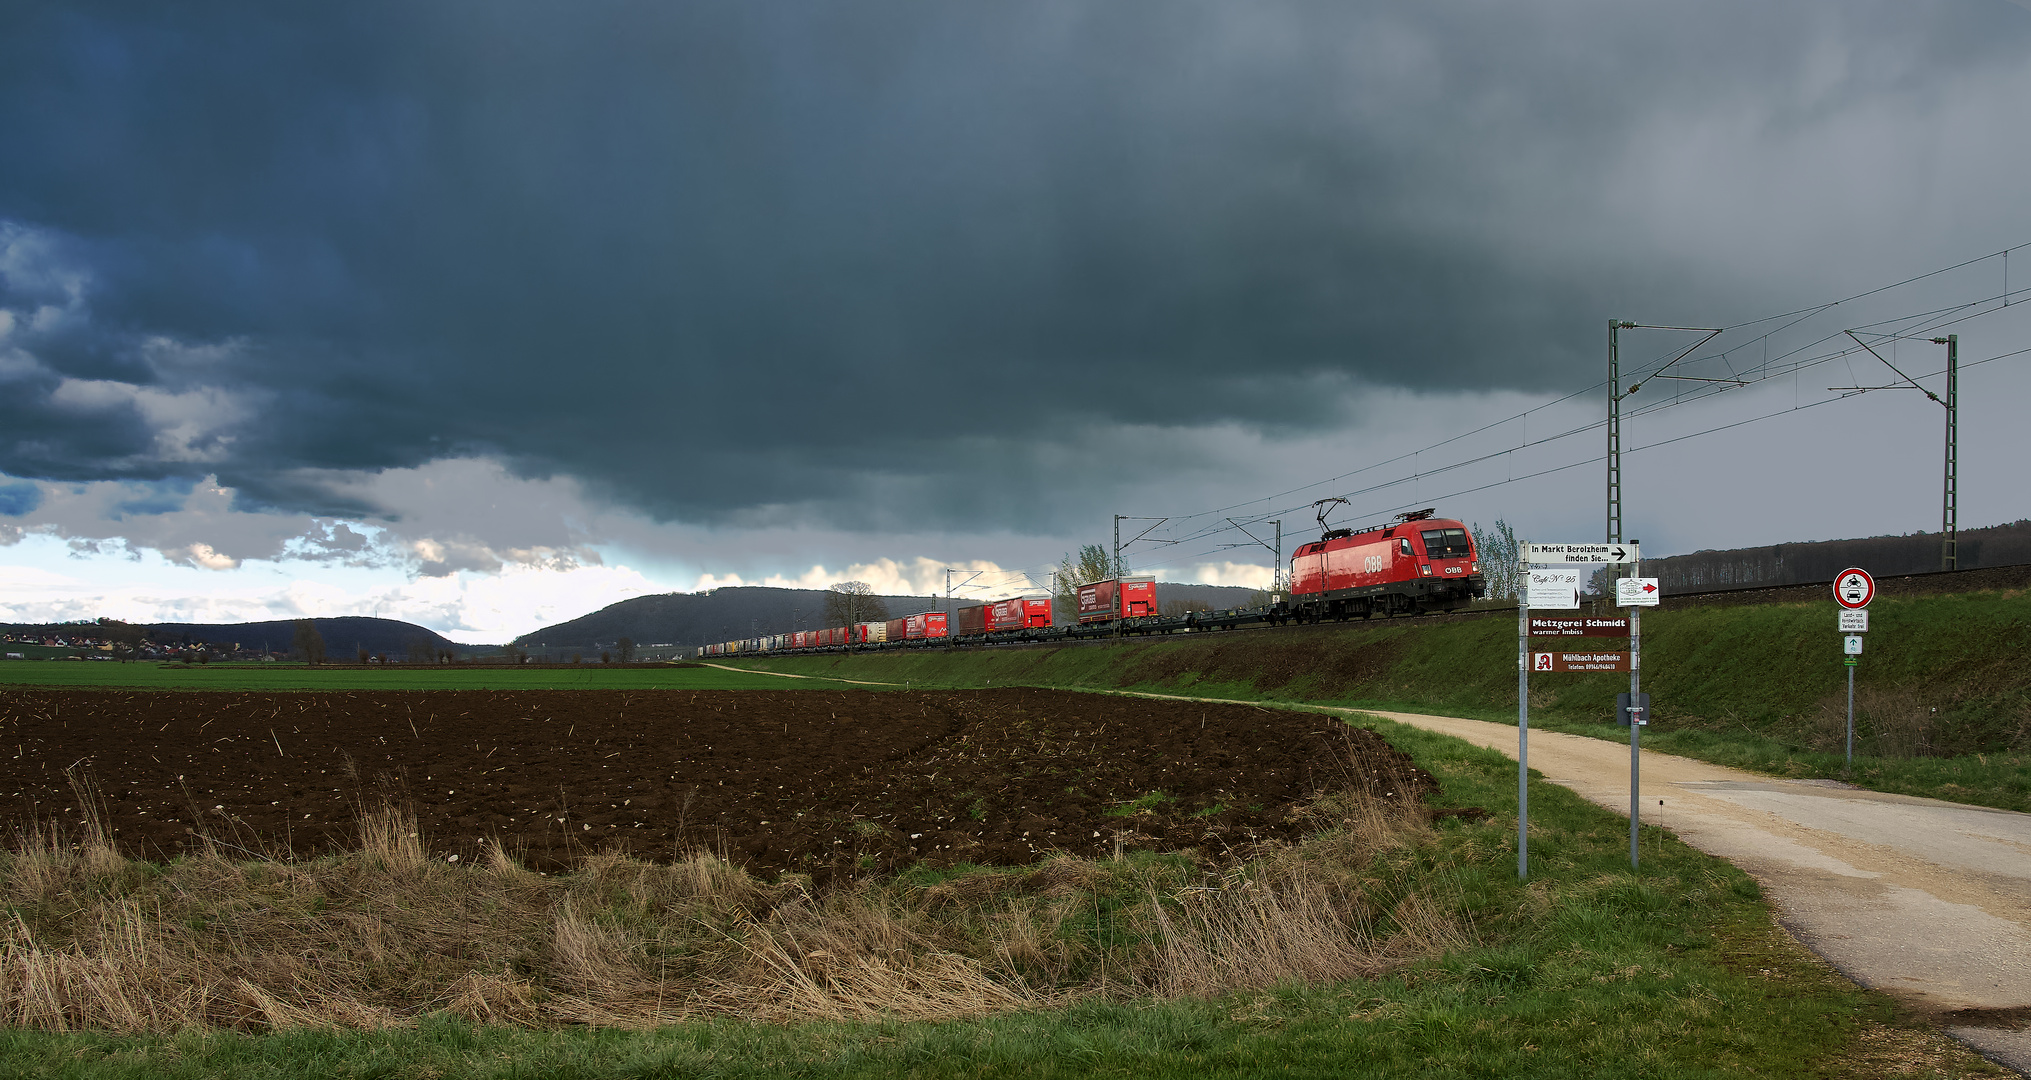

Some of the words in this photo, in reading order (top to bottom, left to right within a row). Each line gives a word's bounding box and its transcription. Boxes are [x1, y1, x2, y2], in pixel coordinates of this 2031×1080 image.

[1567, 545, 1609, 553] Berolzheim
[1565, 554, 1588, 562] finden
[1364, 555, 1383, 574] ÖBB
[1532, 619, 1583, 629] Metzgerei
[1585, 619, 1626, 627] Schmidt
[1562, 653, 1591, 662] Mühlbach
[1592, 653, 1621, 663] Apotheke
